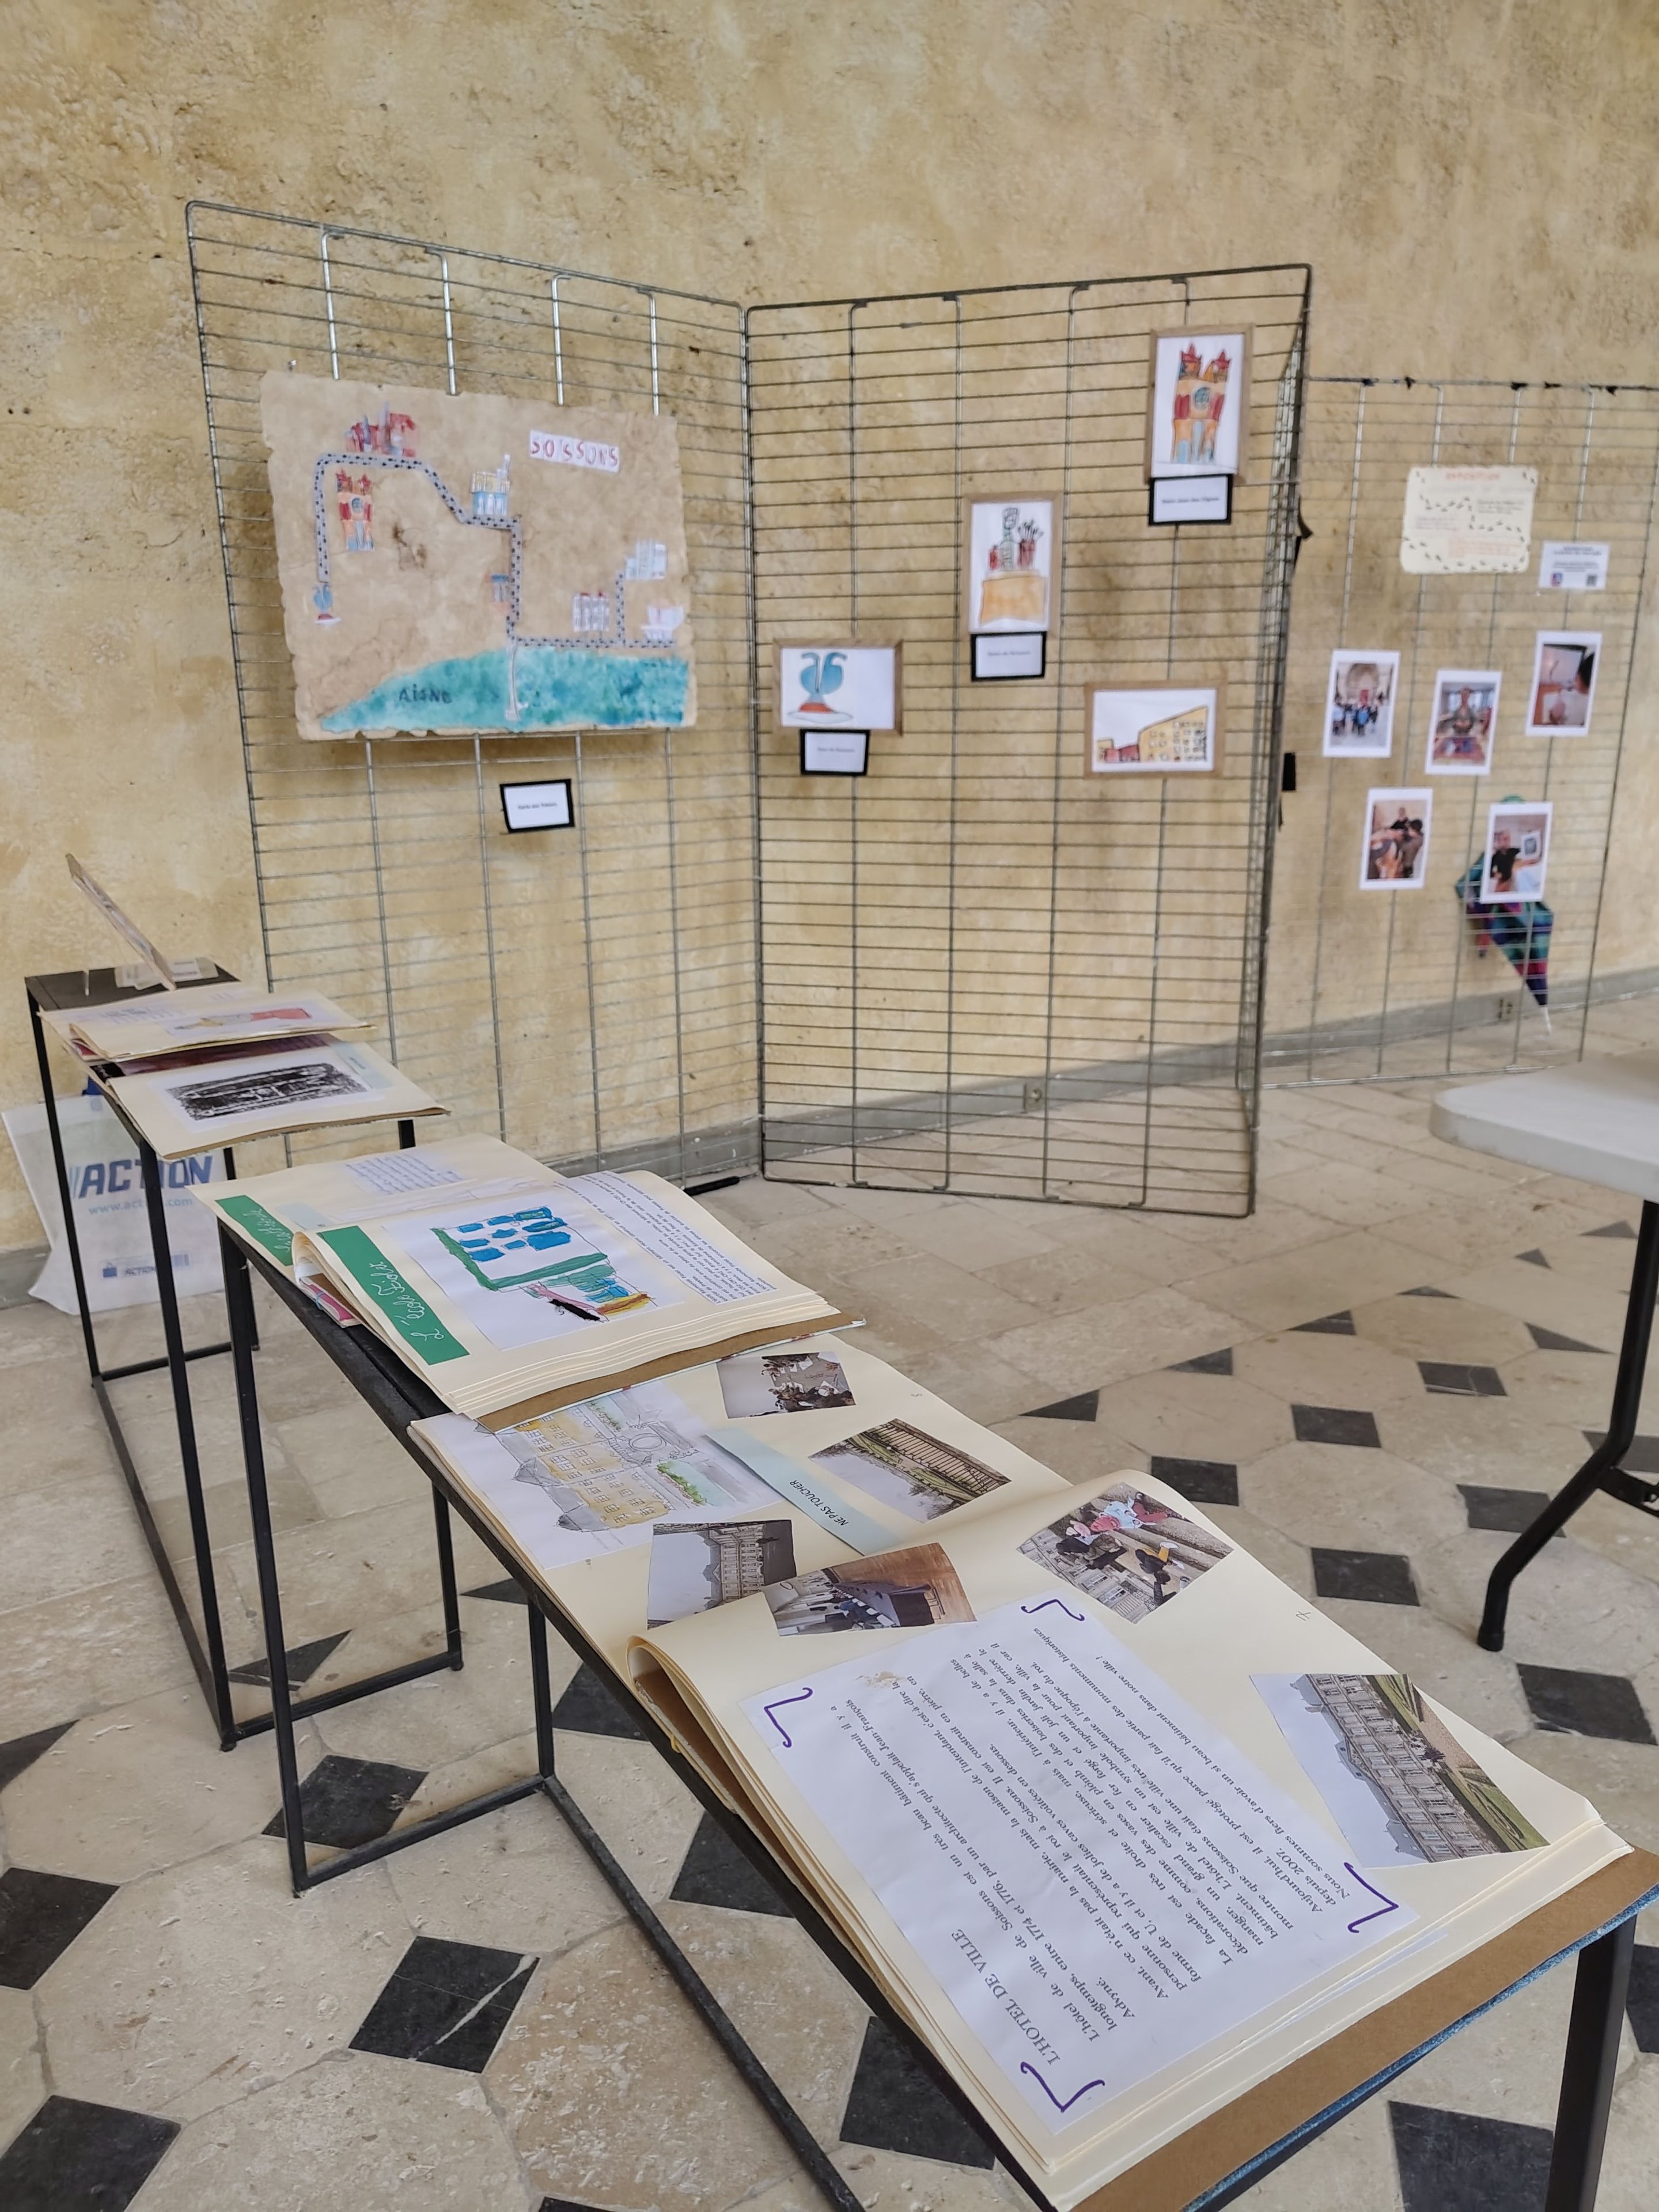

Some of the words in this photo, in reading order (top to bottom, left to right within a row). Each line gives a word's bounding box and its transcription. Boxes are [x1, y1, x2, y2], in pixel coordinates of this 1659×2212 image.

[90, 1198, 193, 1215] www.act.com
[790, 1480, 824, 1507] TOUCHER
[820, 1506, 839, 1519] PAS
[834, 1517, 849, 1526] NE
[1033, 1628, 1070, 1663] historiques
[1000, 1651, 1013, 1661] car
[972, 1661, 988, 1676] salle
[1015, 1664, 1031, 1680] ville,
[1030, 1661, 1044, 1673] roi.
[1103, 1660, 1118, 1675] ville
[892, 1681, 900, 1690] la
[907, 1676, 917, 1685] en
[988, 1678, 998, 1687] la
[1032, 1683, 1041, 1691] la
[1043, 1675, 1054, 1685] du
[1069, 1663, 1112, 1704] monuments
[1118, 1675, 1139, 1694] notre
[919, 1688, 942, 1710] pierre,
[998, 1688, 1016, 1705] dans
[1041, 1694, 1063, 1711] pour
[1054, 1686, 1085, 1717] l'époque
[1138, 1694, 1157, 1711] dans
[899, 1691, 934, 1728] c'est-à-dire
[940, 1713, 950, 1723] en
[1111, 1705, 1126, 1718] des
[846, 1699, 889, 1752] Jean-François
[1016, 1708, 1048, 1741] boiseries
[1060, 1714, 1099, 1750] important
[1126, 1719, 1152, 1740] partie
[1156, 1712, 1192, 1745] bâtiment
[850, 1732, 880, 1767] construit
[934, 1729, 972, 1774] l'intendant,
[949, 1726, 982, 1759] construit
[1048, 1743, 1063, 1756] des
[1090, 1724, 1132, 1763] importante
[1147, 1741, 1164, 1755] fait
[1063, 1759, 1074, 1767] et
[1161, 1756, 1183, 1774] qu'il
[1191, 1745, 1213, 1766] beau
[886, 1752, 920, 1787] s'appelait
[981, 1762, 994, 1773] est
[1099, 1752, 1132, 1784] symbole
[1131, 1763, 1147, 1779] très
[880, 1770, 912, 1806] bâtiment
[971, 1774, 983, 1785] de
[992, 1776, 1004, 1785] Il
[1142, 1779, 1164, 1797] ville
[1183, 1775, 1209, 1797] parce
[1221, 1774, 1234, 1786] un
[916, 1789, 934, 1803] qui
[983, 1786, 1011, 1816] maison
[1134, 1787, 1146, 1800] un
[1234, 1786, 1264, 1813] d'avoir
[1006, 1786, 1039, 1823] Soissons.
[1103, 1799, 1115, 1810] en
[1147, 1803, 1162, 1815] est
[1165, 1798, 1183, 1815] une
[912, 1809, 932, 1831] beau
[931, 1805, 968, 1844] architecte
[1010, 1817, 1020, 1828] la
[1116, 1813, 1138, 1836] vases
[1181, 1815, 1202, 1834] était
[1205, 1799, 1242, 1831] protégé
[1164, 1819, 1182, 1838] ville
[1264, 1815, 1285, 1835] fiers
[933, 1833, 949, 1850] très
[1020, 1828, 1040, 1850] mais
[1046, 1834, 1062, 1849] roi
[1141, 1839, 1157, 1855] des
[1185, 1841, 1198, 1853] de
[1239, 1832, 1253, 1844] est
[967, 1846, 979, 1860] un
[1062, 1851, 1073, 1862] le
[1202, 1836, 1239, 1874] Soissons
[1252, 1846, 1263, 1855] il
[1285, 1835, 1323, 1872] sommes
[950, 1854, 963, 1868] un
[978, 1862, 997, 1878] par
[1041, 1851, 1069, 1884] mairie,
[1275, 1847, 1305, 1875] 2007.
[963, 1871, 977, 1885] est
[1158, 1859, 1191, 1893] comme
[1197, 1857, 1232, 1890] L'hôtel
[993, 1880, 1015, 1905] 1776,
[1069, 1885, 1080, 1897] la
[1072, 1863, 1123, 1919] représentait
[1239, 1875, 1258, 1892] que
[1264, 1855, 1323, 1912] Aujourd'hui,
[1304, 1875, 1336, 1905] depuis
[1323, 1873, 1351, 1899] Nous
[978, 1890, 1013, 1931] Soissons
[1013, 1904, 1025, 1914] et
[1079, 1897, 1099, 1914] pas
[1258, 1894, 1294, 1930] montre
[1196, 1897, 1248, 1954] décorations,
[1235, 1892, 1279, 1940] bâtiment.
[1022, 1917, 1045, 1941] 1774
[1094, 1916, 1123, 1949] n'était
[1121, 1922, 1141, 1940] qui
[1014, 1935, 1027, 1948] de
[951, 1929, 987, 1974] VILLE
[1044, 1942, 1067, 1971] entre
[1123, 1951, 1136, 1964] ce
[1029, 1955, 1047, 1979] ville
[1142, 1944, 1188, 1991] personne
[984, 1974, 1008, 1999] DE
[1051, 1983, 1064, 1997] de
[1137, 1966, 1169, 1998] Avant,
[1070, 1973, 1118, 2031] longtemps,
[1096, 1976, 1135, 2017] Advyné.
[1005, 1998, 1060, 2065] L'HOTEL
[1063, 2002, 1100, 2042] L'hôtel
